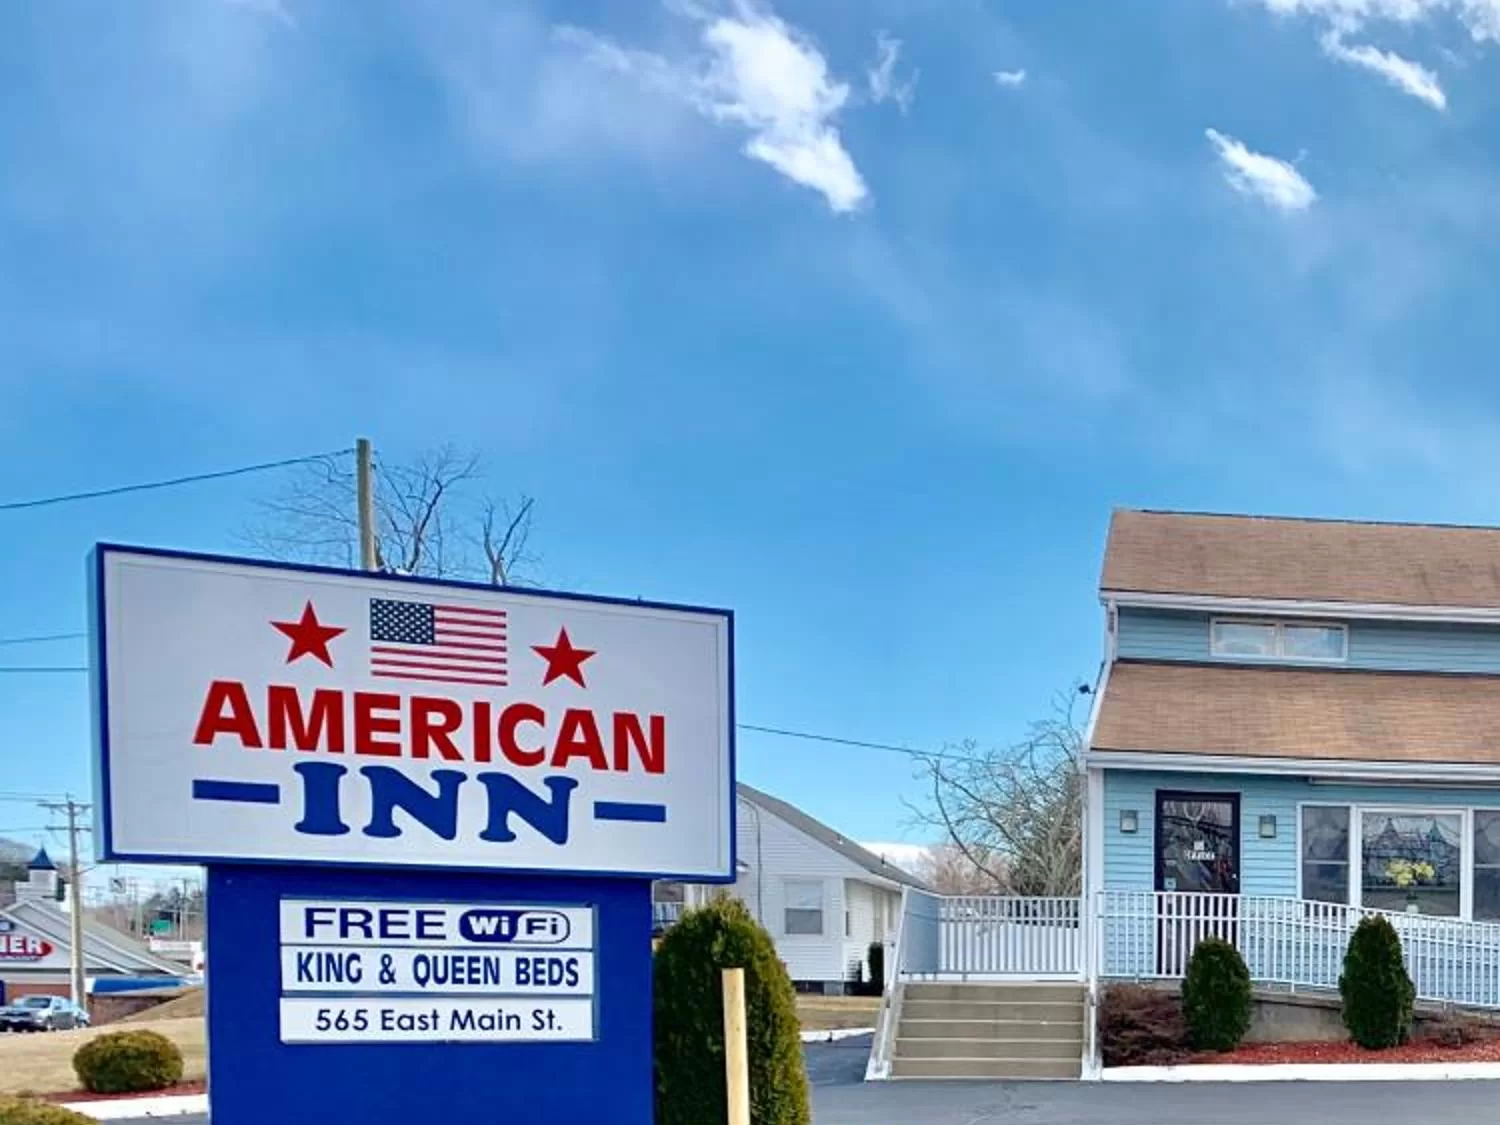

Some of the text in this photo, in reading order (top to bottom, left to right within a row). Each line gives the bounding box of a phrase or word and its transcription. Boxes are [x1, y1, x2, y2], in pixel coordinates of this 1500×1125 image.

[193, 680, 666, 775] AMERICAN
[293, 761, 579, 846] INN
[304, 907, 447, 940] FREE
[297, 951, 579, 989] KING & QUEEN BEDS
[315, 1009, 563, 1032] 565 East Main St.
